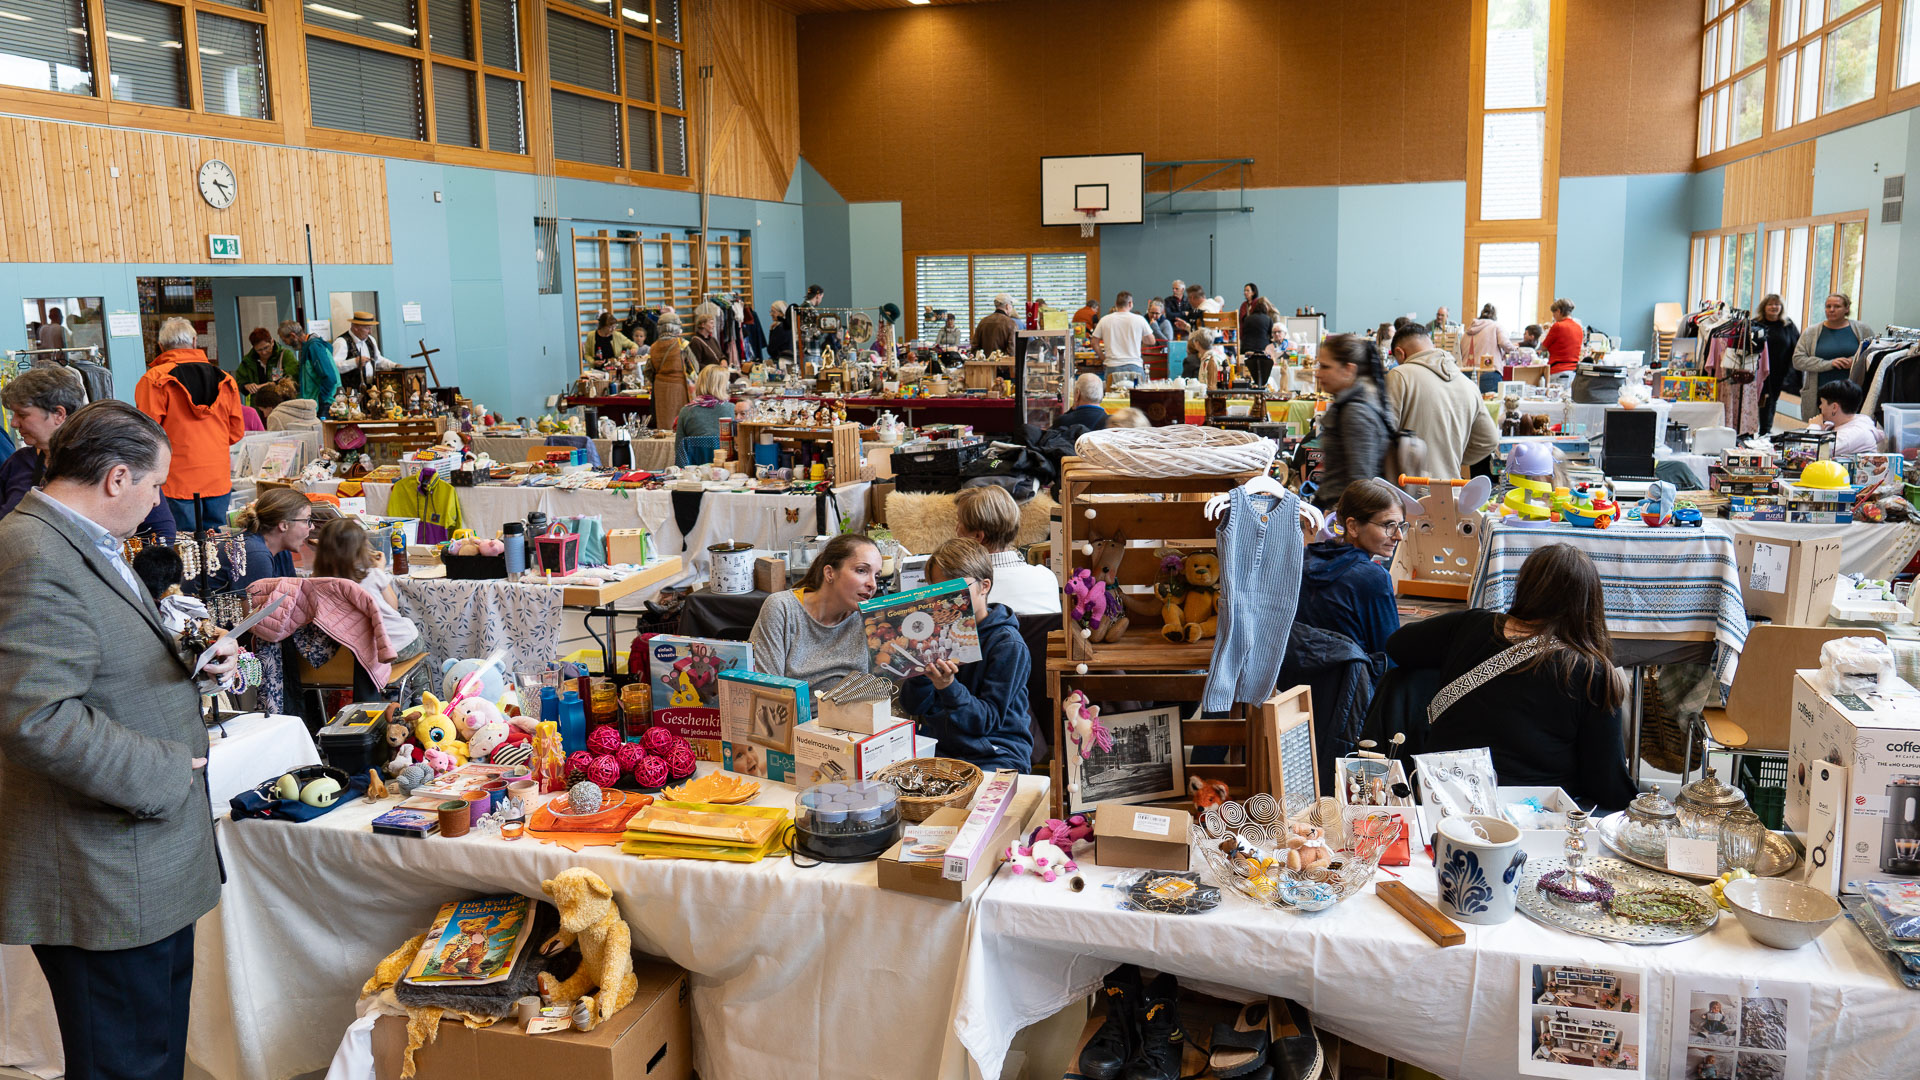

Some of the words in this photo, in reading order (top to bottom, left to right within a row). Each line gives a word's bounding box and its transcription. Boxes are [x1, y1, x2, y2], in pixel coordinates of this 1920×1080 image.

[888, 606, 918, 618] Gourmet
[918, 602, 935, 611] Party
[733, 697, 750, 708] ART
[797, 736, 840, 753] Nudelmaschine
[460, 901, 525, 914] Teddybären
[484, 899, 507, 907] Welt
